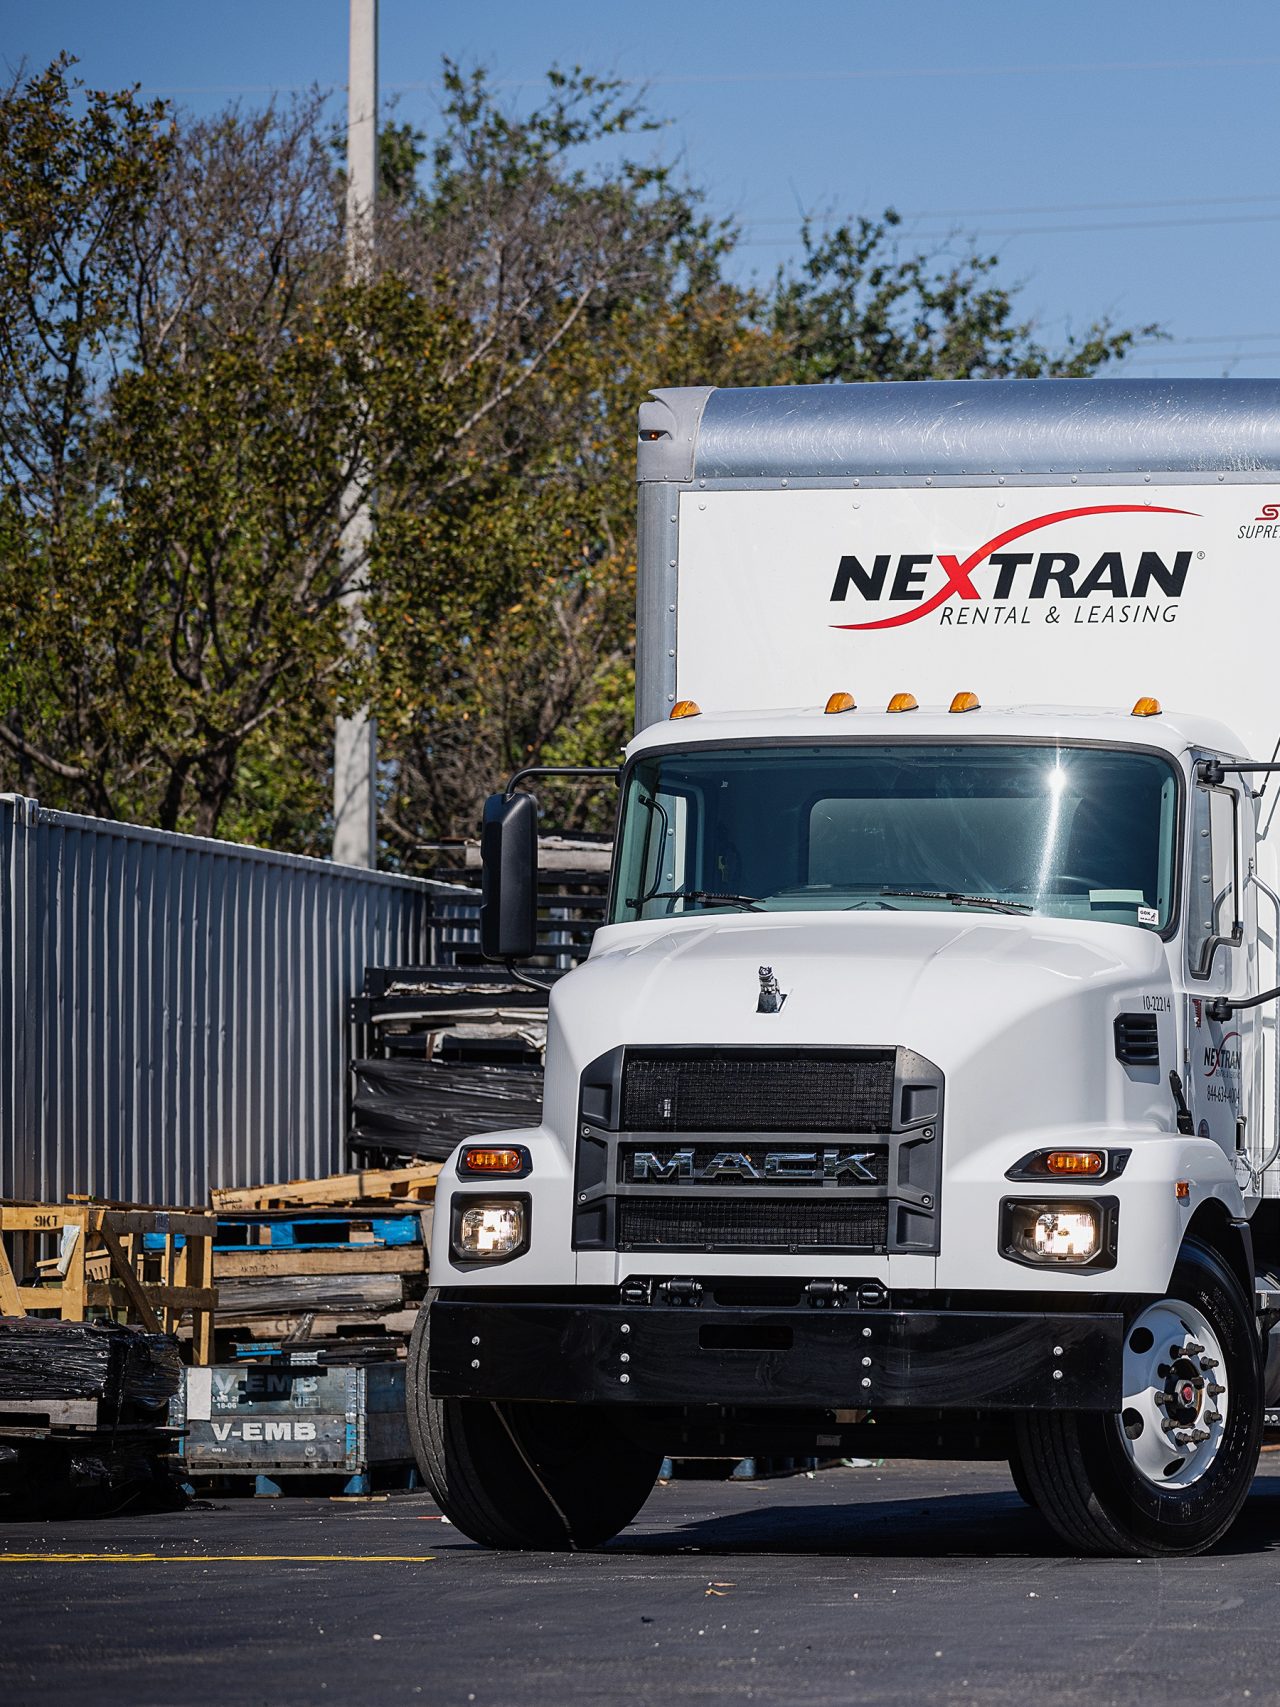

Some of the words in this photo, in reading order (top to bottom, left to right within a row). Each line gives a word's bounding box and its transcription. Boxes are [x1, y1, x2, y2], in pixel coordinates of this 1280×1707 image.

[940, 606, 1031, 625] RENTAL
[1045, 606, 1060, 623] &
[1074, 604, 1179, 624] LEASING
[634, 1151, 877, 1180] MACK
[211, 1422, 317, 1441] V-EMB
